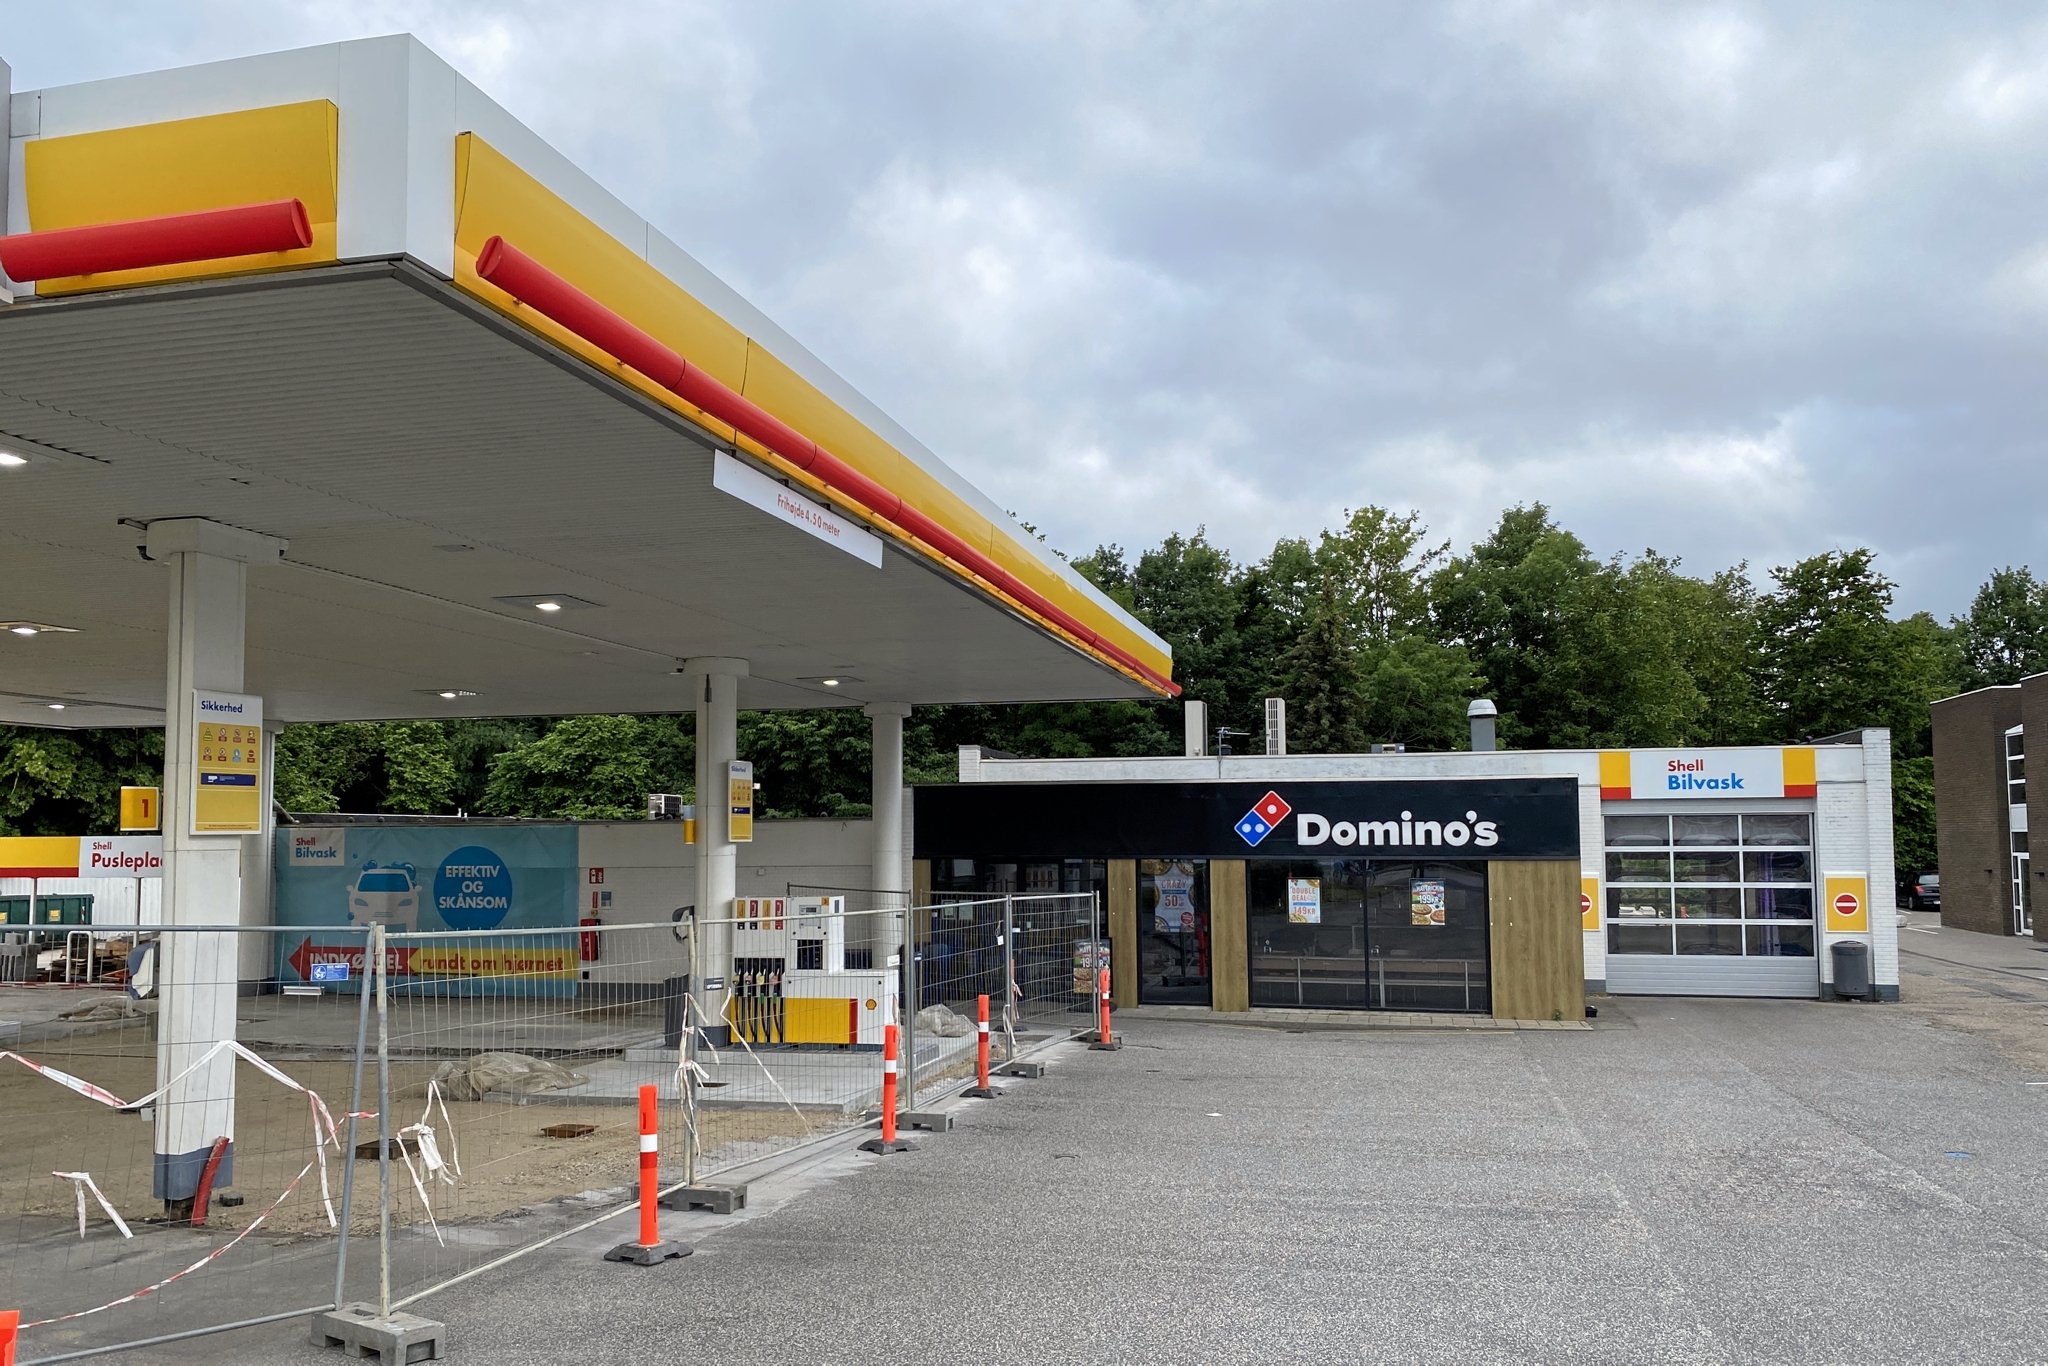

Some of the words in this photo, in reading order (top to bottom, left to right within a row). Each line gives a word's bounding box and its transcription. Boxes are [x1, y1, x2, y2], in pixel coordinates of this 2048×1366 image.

[777, 493, 804, 519] Frihøjde
[823, 522, 840, 537] meter
[201, 700, 243, 713] Sikkerhed
[1668, 759, 1704, 771] Shell
[1668, 772, 1744, 790] Bilvask
[142, 799, 149, 818] 1
[1297, 810, 1499, 847] Domino's
[92, 841, 112, 850] Shell
[296, 837, 316, 846] Shell
[295, 847, 337, 858] Bilvask
[91, 851, 163, 872] Puslepla
[445, 865, 500, 878] EFFEKTIV
[461, 881, 484, 894] OG
[1161, 879, 1187, 889] CRAZY
[1292, 887, 1316, 895] DOUBLE
[439, 893, 508, 909] SKÅNSOM
[1292, 894, 1307, 902] DEAL
[310, 952, 403, 970] INDKØEL
[420, 953, 466, 970] rundt
[471, 957, 497, 971] om
[502, 953, 564, 975] hjørnet
